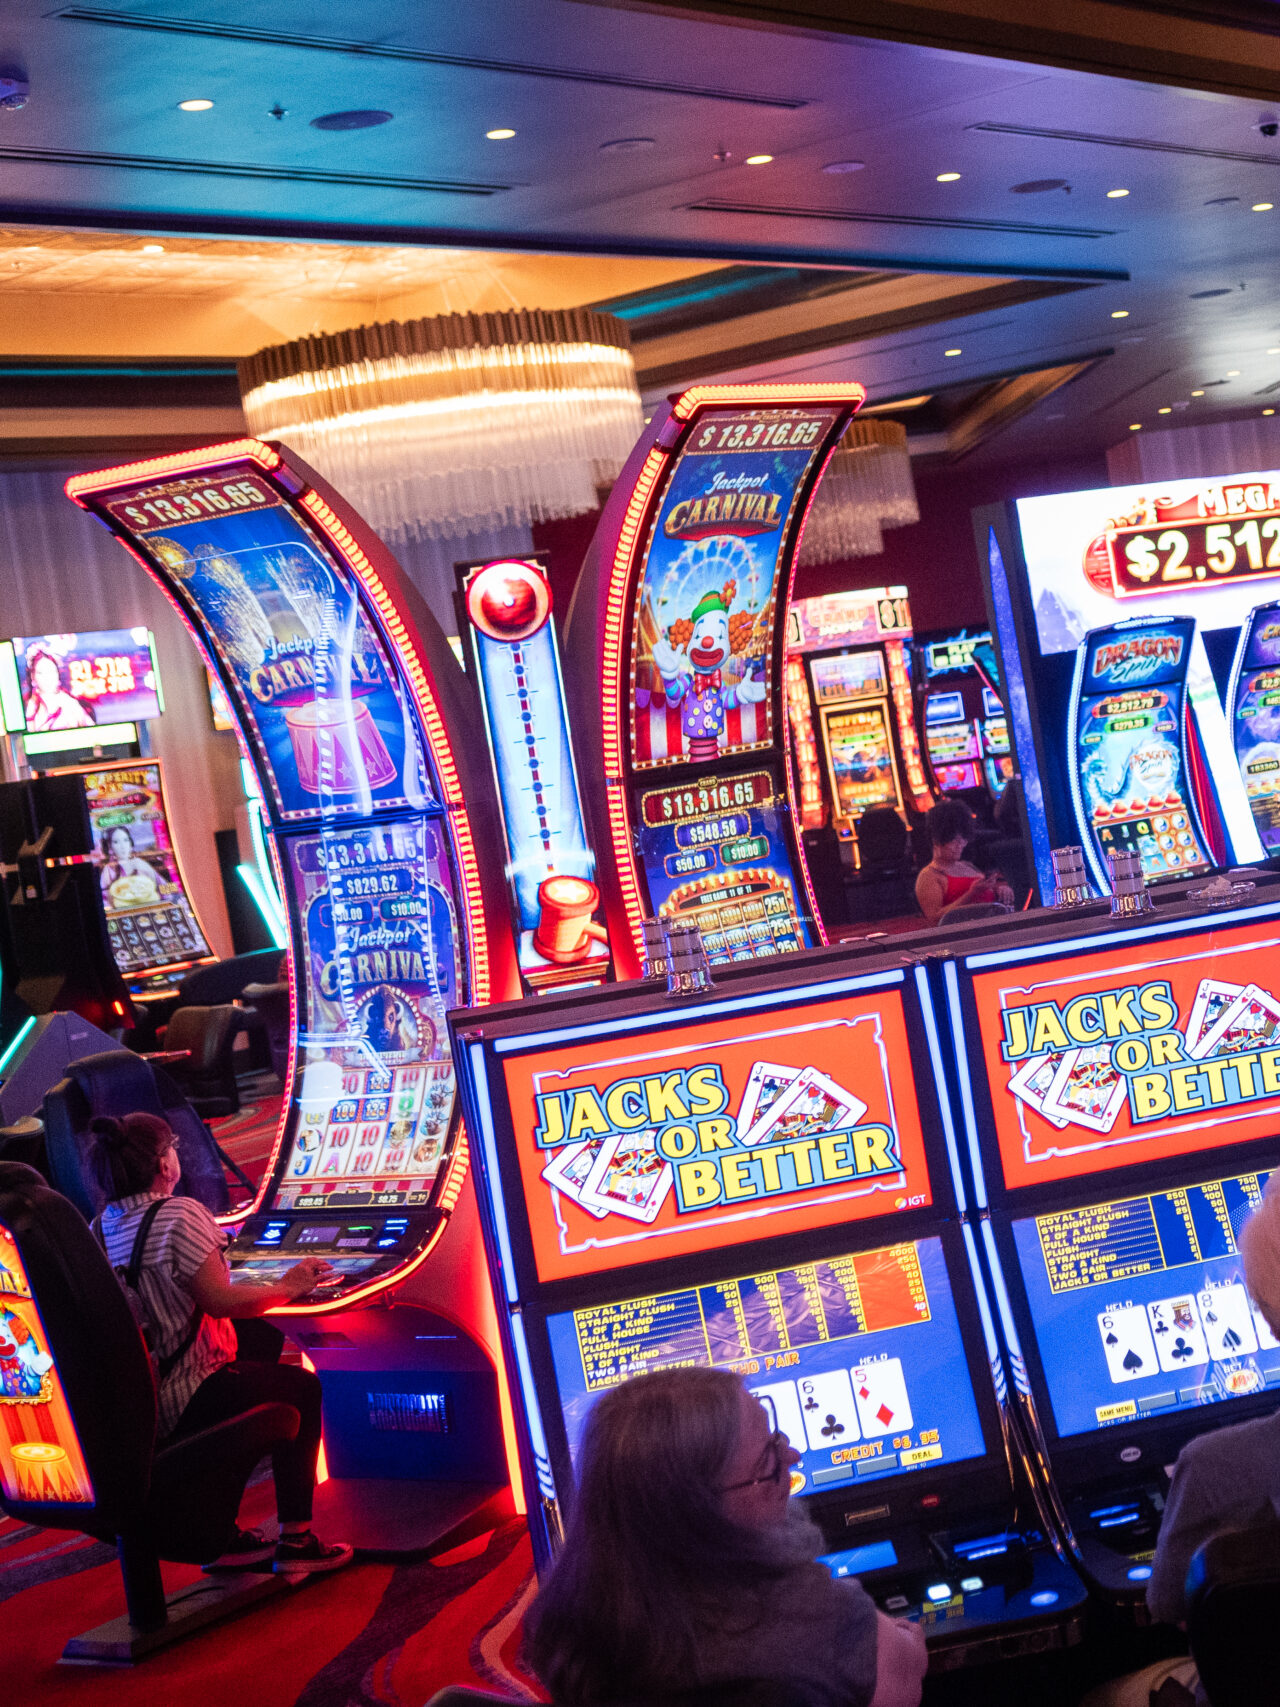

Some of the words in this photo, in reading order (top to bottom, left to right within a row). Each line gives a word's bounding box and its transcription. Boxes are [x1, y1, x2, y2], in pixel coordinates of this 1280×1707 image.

[705, 472, 769, 493] Jackpot
[665, 493, 783, 535] CARNIVAL
[1094, 637, 1182, 676] DRAGON
[690, 819, 737, 843] $548.58
[675, 854, 706, 872] $50.00
[731, 844, 759, 860] $10.00
[347, 874, 398, 895] $829.62
[700, 894, 713, 904] FREE
[736, 886, 744, 895] OF
[391, 902, 422, 916] $10.00
[349, 923, 412, 951] Jackpot
[1005, 982, 1175, 1058] JACKS
[1114, 1034, 1183, 1073] OR
[540, 1067, 725, 1145] JACKS
[659, 1119, 736, 1160] OR
[678, 1127, 896, 1208] BETTER
[908, 1194, 926, 1207] IGT
[1039, 1214, 1075, 1227] ROYAL
[1079, 1206, 1112, 1218] FLUSH
[1166, 1190, 1184, 1201] 250
[1201, 1183, 1219, 1193] 500
[1238, 1176, 1255, 1186] 750
[1041, 1217, 1092, 1235] STRAIGHT
[1096, 1210, 1129, 1223] FLUSH
[1174, 1199, 1186, 1208] 50
[1204, 1191, 1221, 1201] 100
[1240, 1184, 1257, 1193] 150
[1055, 1231, 1067, 1240] OF
[1084, 1222, 1110, 1234] KIND
[1176, 1207, 1188, 1215] 25
[1210, 1199, 1223, 1208] 50
[1045, 1240, 1069, 1251] FULL
[1073, 1231, 1107, 1245] HOUSE
[1047, 1246, 1080, 1259] FLUSH
[1048, 1249, 1100, 1267] STRAIGHT
[1061, 1263, 1075, 1272] OF
[1092, 1254, 1117, 1266] KIND
[576, 1307, 617, 1321] ROYAL
[620, 1299, 657, 1313] FLUSH
[716, 1282, 736, 1293] 250
[754, 1274, 774, 1285] 500
[794, 1267, 813, 1277] 750
[828, 1259, 852, 1270] 1000
[889, 1246, 914, 1257] 4000
[1052, 1271, 1078, 1283] TWO
[1082, 1265, 1107, 1277] PAIR
[1054, 1276, 1090, 1291] JACKS
[1093, 1271, 1109, 1281] OR
[1112, 1263, 1151, 1279] BETTER
[578, 1310, 635, 1330] STRAIGHT
[639, 1303, 675, 1317] FLUSH
[757, 1283, 775, 1293] 100
[797, 1275, 814, 1285] 150
[834, 1267, 854, 1277] 200
[897, 1254, 916, 1264] 250
[1205, 1278, 1232, 1292] HELD
[593, 1325, 607, 1335] OF
[625, 1316, 654, 1327] KIND
[837, 1275, 855, 1285] 100
[900, 1263, 918, 1273] 125
[1105, 1300, 1133, 1313] HELD
[1202, 1293, 1213, 1308] 8
[1152, 1304, 1164, 1320] K
[1102, 1315, 1114, 1330] 6
[581, 1334, 609, 1346] FULL
[612, 1325, 650, 1340] HOUSE
[583, 1340, 619, 1355] FLUSH
[585, 1344, 641, 1363] STRAIGHT
[599, 1358, 613, 1368] OF
[631, 1349, 659, 1362] KIND
[765, 1352, 801, 1369] PAIR
[859, 1353, 888, 1366] HELD
[588, 1367, 616, 1380] TWO
[620, 1360, 647, 1374] PAIR
[854, 1369, 867, 1383] 5
[590, 1374, 628, 1388] JACKS
[802, 1380, 814, 1394] 6
[1099, 1408, 1116, 1419] GAME
[831, 1441, 884, 1465] CREDIT
[912, 1451, 933, 1461] DEAL
